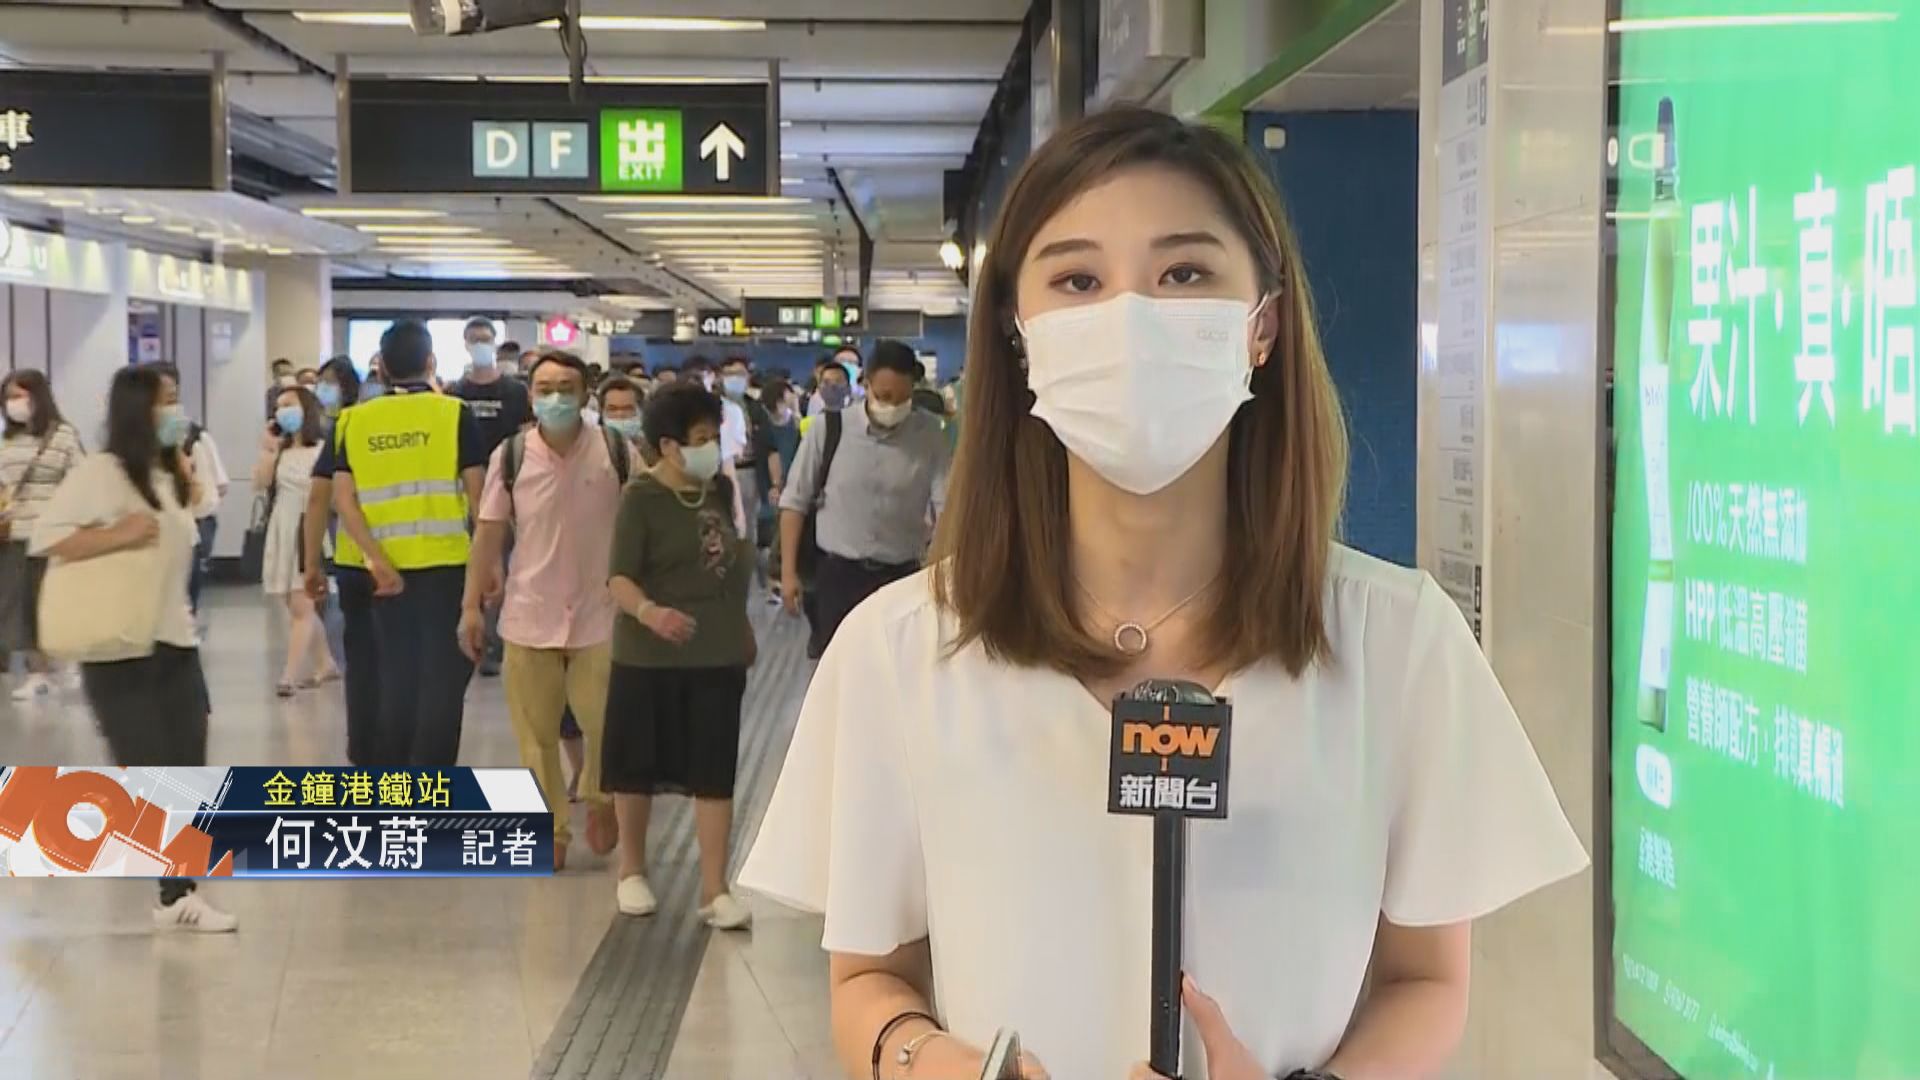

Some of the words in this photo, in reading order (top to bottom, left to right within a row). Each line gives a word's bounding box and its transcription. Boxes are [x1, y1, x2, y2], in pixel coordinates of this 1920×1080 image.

[486, 129, 518, 169] D
[549, 131, 573, 170] F
[617, 119, 666, 163] 出
[618, 162, 664, 181] EXIT
[367, 431, 431, 453] SECURITY
[1685, 577, 1716, 643] HPP
[1122, 722, 1220, 757] now
[1119, 774, 1217, 810] 新聞台
